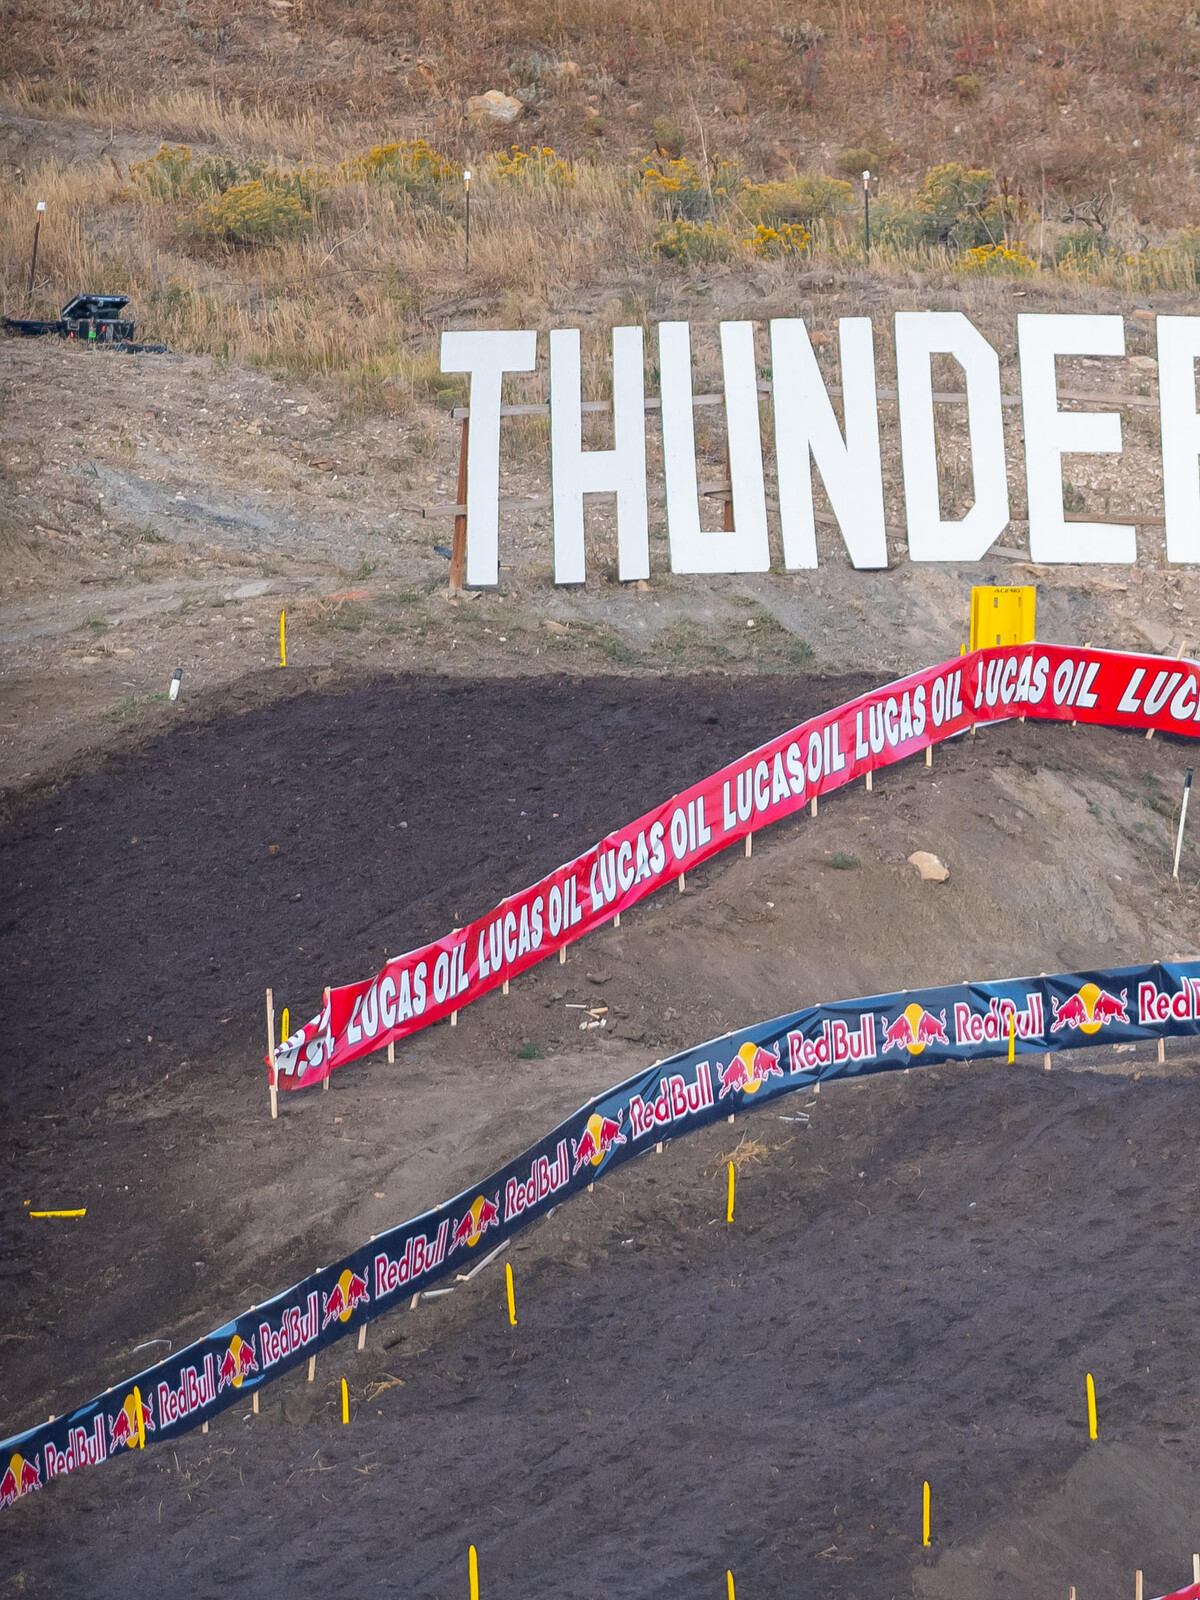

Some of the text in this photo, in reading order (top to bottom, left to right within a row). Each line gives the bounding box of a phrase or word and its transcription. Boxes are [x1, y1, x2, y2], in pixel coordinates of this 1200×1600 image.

[346, 960, 427, 1046] LUCAS
[433, 945, 469, 1004] OIL
[478, 895, 544, 980] LUCAS
[548, 874, 583, 938] OIL
[590, 820, 666, 912] LUCAS
[670, 795, 712, 861] OIL
[723, 742, 806, 833] LUCAS
[806, 722, 845, 783] OIL
[855, 684, 926, 761] LUCAS
[931, 669, 964, 728] OIL
[974, 655, 1050, 710] LUCAS
[1053, 658, 1101, 709] OIL
[44, 1428, 77, 1480] Red
[75, 1412, 107, 1468] Bull
[158, 1368, 187, 1429] Red
[187, 1353, 216, 1416] Bull
[259, 1310, 289, 1370] Red
[288, 1290, 318, 1351] Bull
[375, 1237, 412, 1300] Red
[410, 1218, 449, 1278] Bull
[504, 1159, 537, 1222] Red
[536, 1138, 569, 1202] Bull
[629, 1077, 671, 1140] Red
[669, 1060, 714, 1121] Bull
[787, 1019, 831, 1075] Red
[830, 1012, 876, 1064] Bull
[953, 997, 1000, 1046] Red
[999, 992, 1045, 1041] Bull
[1138, 976, 1193, 1024] Red
